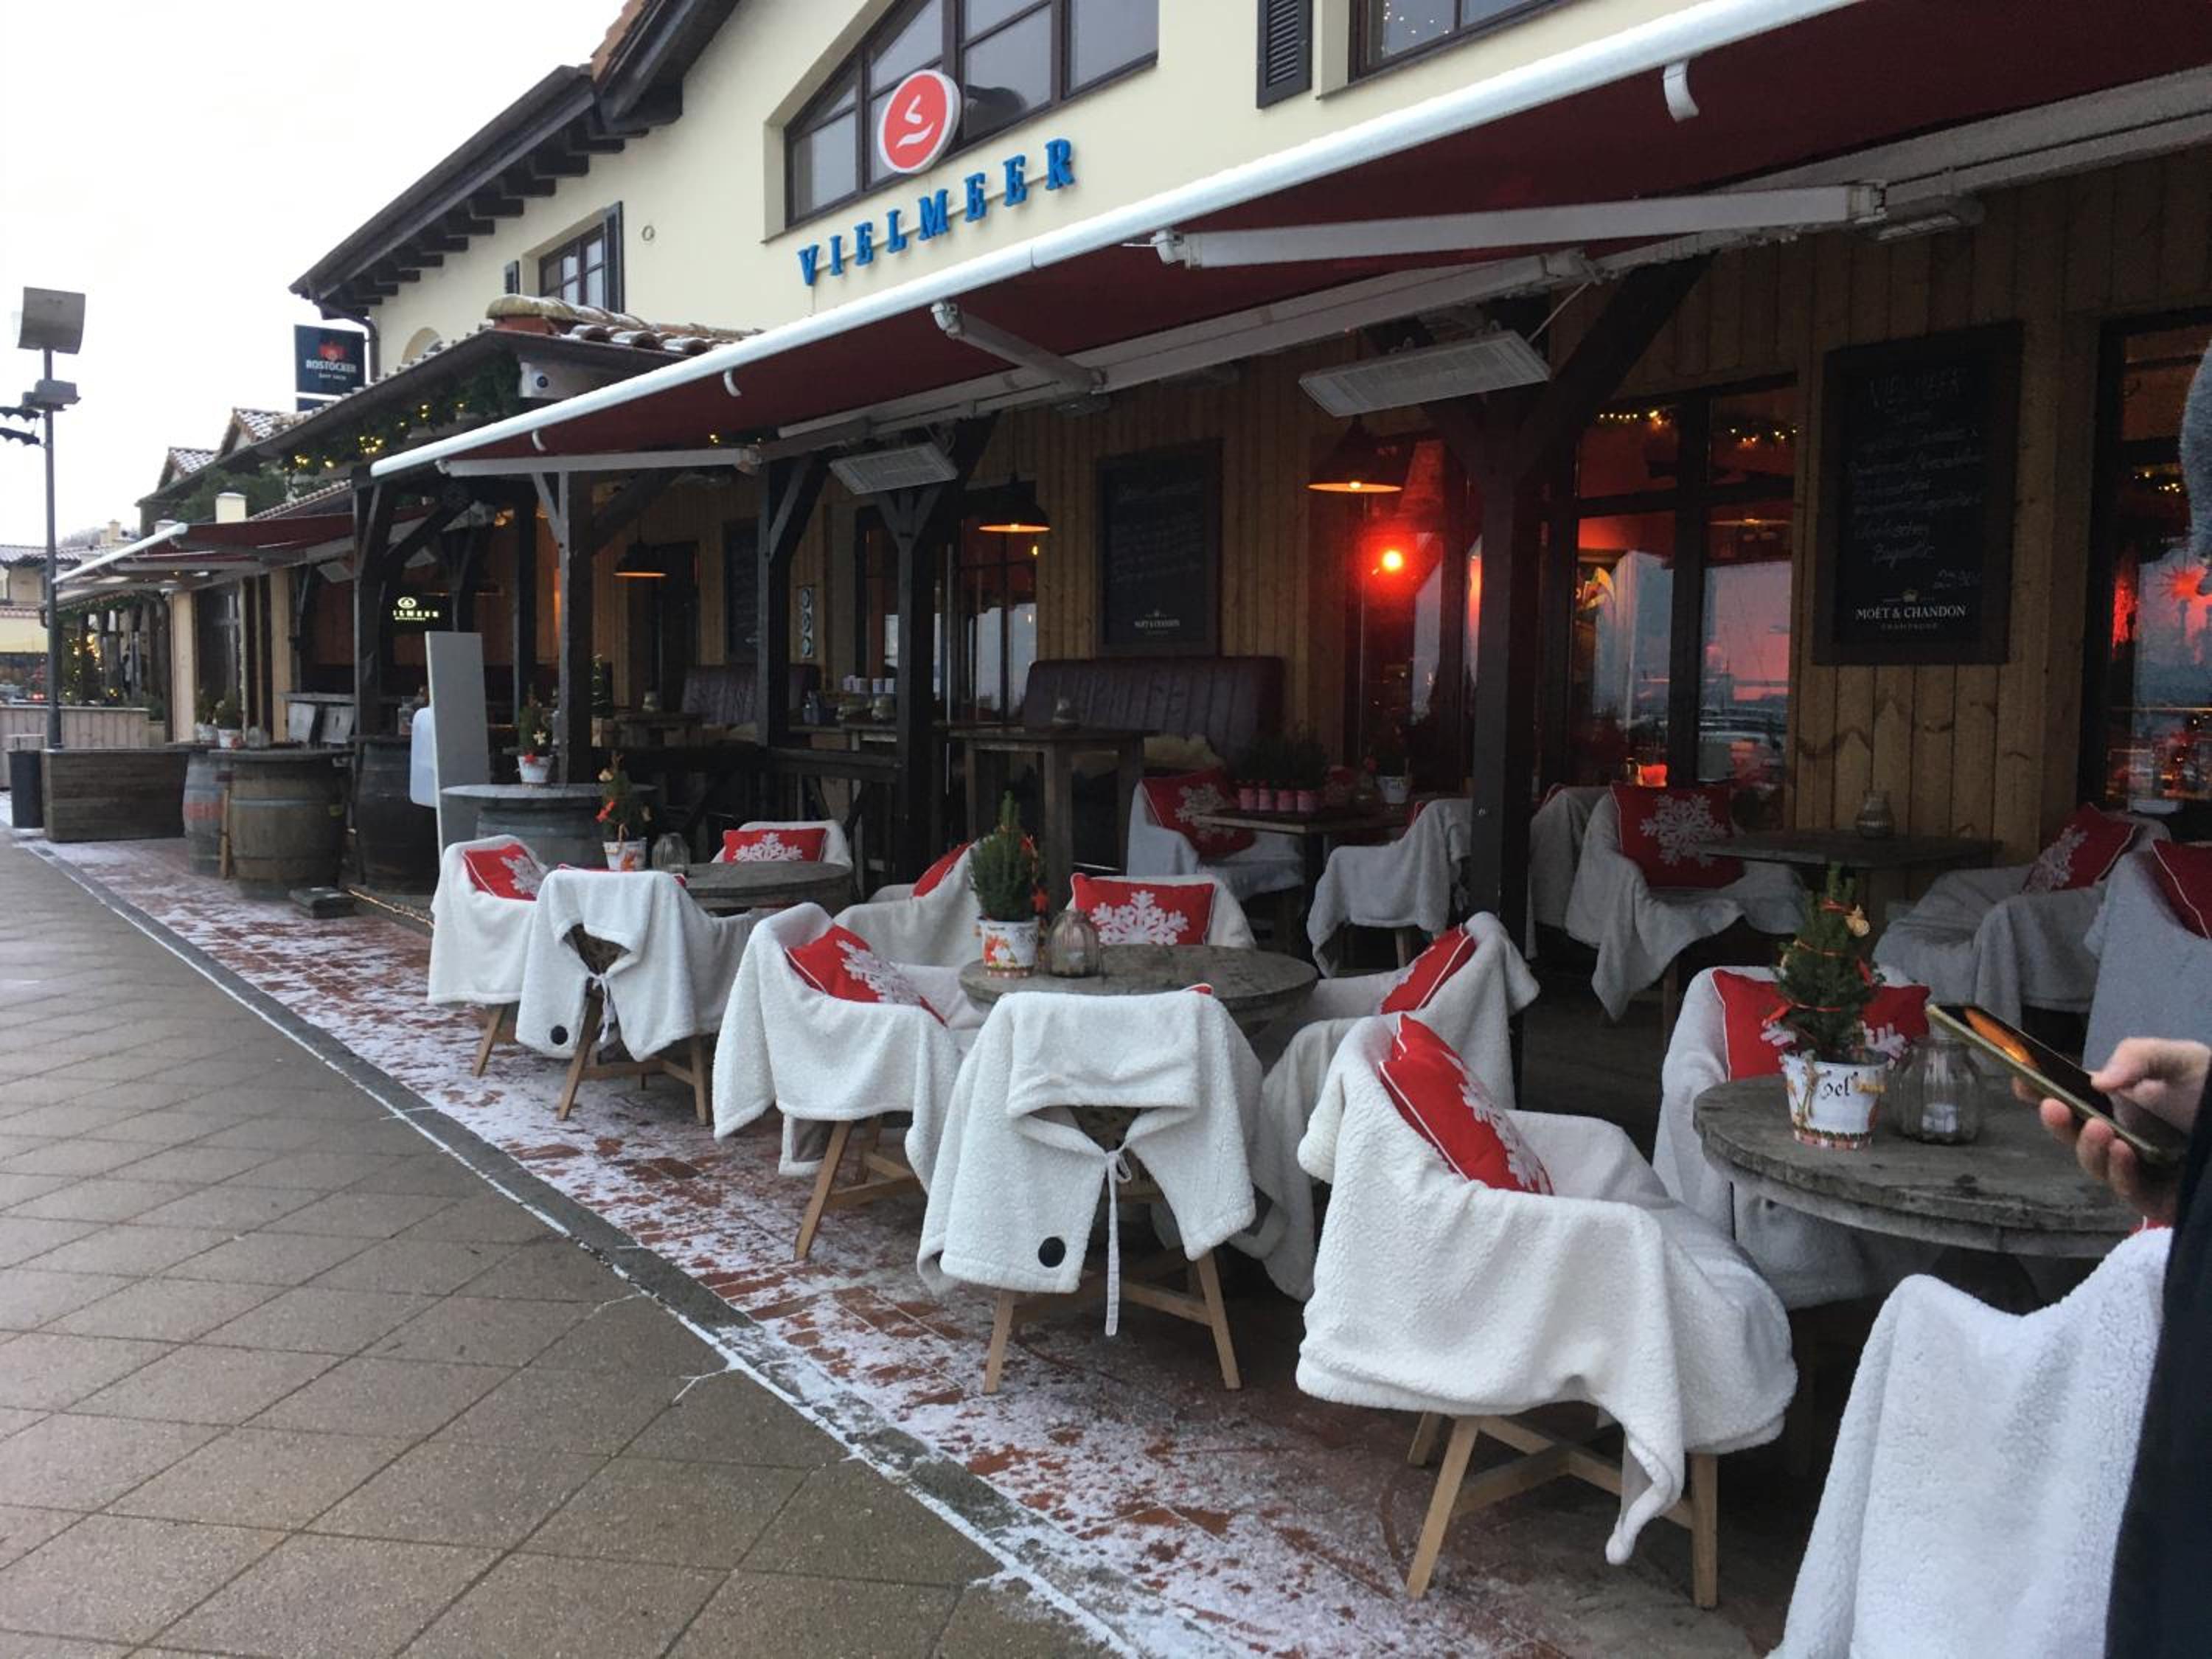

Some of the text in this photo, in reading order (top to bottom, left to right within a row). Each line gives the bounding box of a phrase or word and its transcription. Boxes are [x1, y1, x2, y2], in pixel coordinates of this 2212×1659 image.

[797, 137, 1077, 286] VIELMEER
[305, 359, 357, 373] ROSTOCKER
[1891, 608, 1901, 619] &
[1904, 605, 1966, 619] CHANDON
